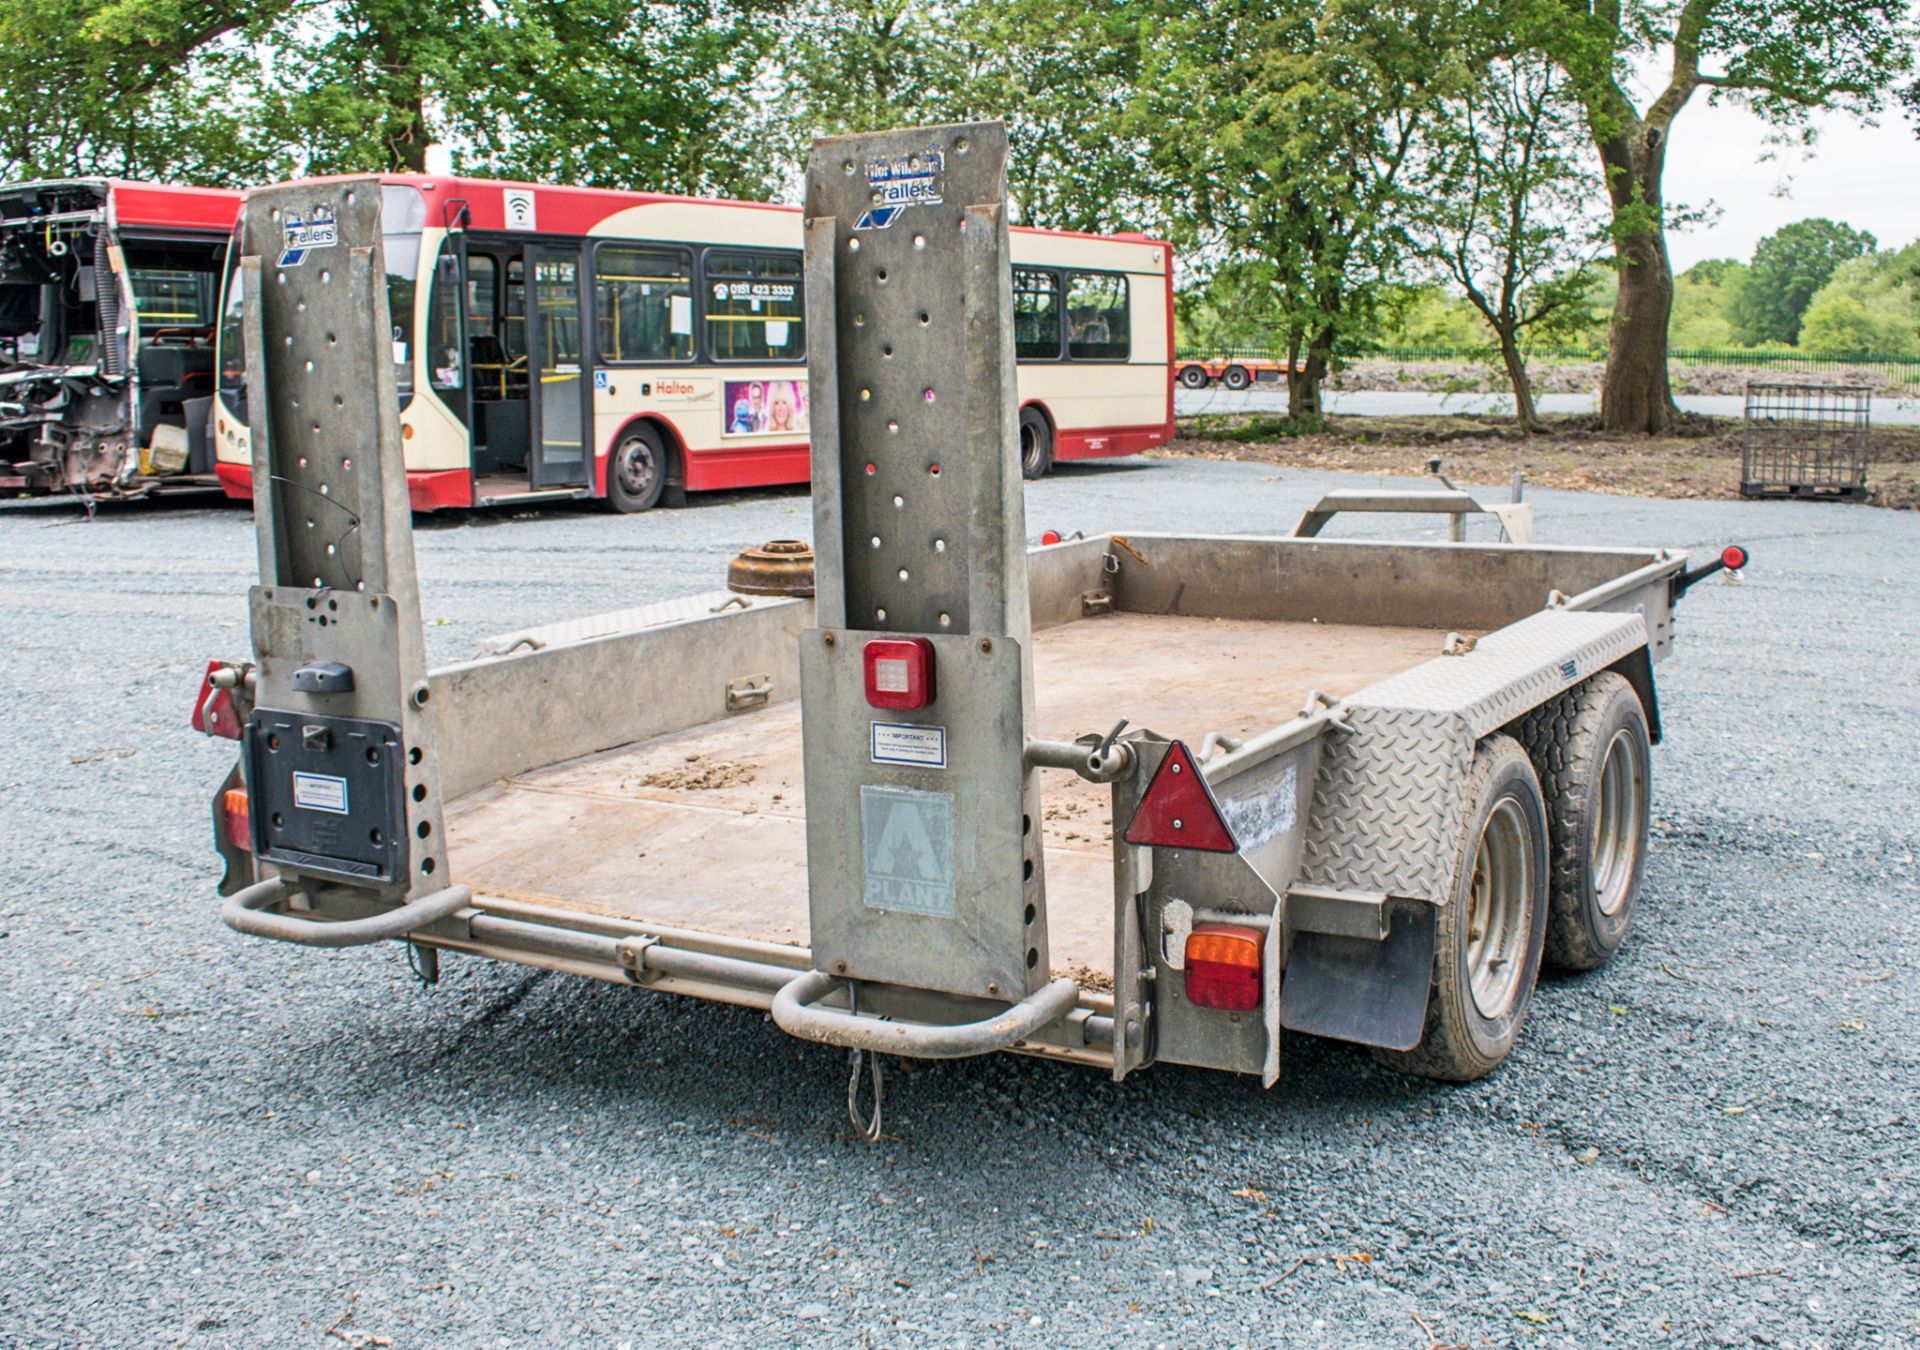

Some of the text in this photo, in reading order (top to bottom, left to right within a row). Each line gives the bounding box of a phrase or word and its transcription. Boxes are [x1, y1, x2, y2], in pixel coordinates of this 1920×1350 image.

[287, 230, 333, 243] Tailers
[730, 283, 794, 296] 0151 423 3333
[656, 381, 695, 394] Halton
[892, 732, 925, 741] IMPORTANT
[871, 801, 942, 879] A
[866, 879, 949, 907] PLANT
